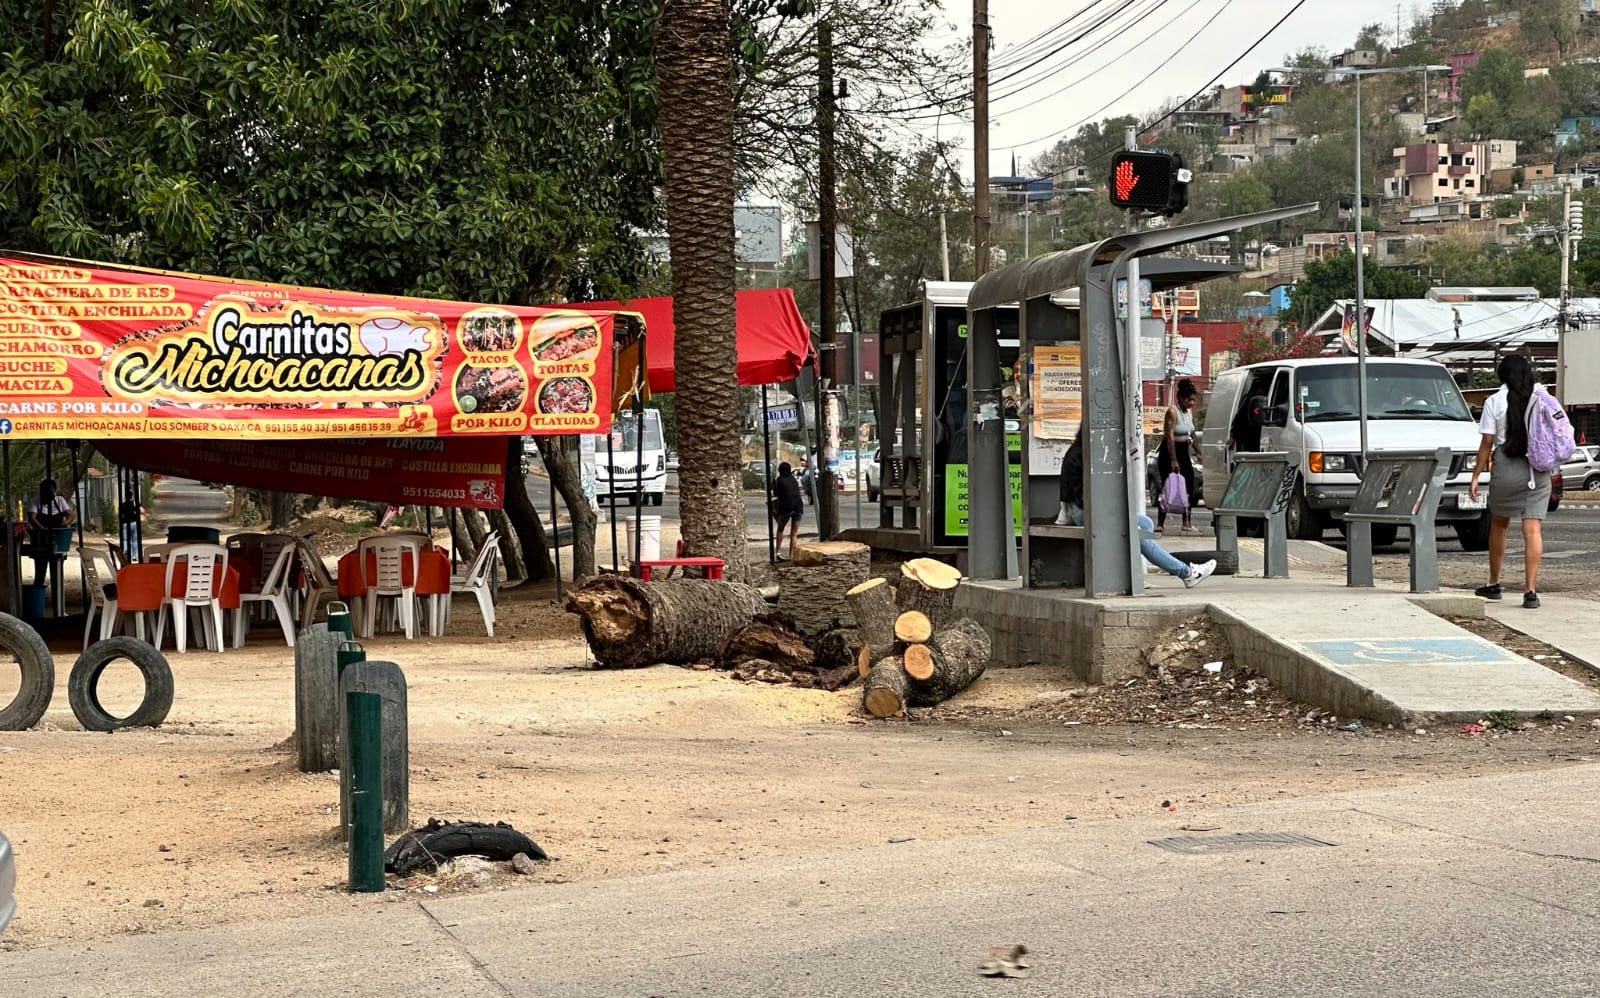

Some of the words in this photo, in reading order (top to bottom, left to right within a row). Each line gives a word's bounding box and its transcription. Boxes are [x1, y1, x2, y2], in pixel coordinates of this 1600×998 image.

[0, 286, 104, 298] ARRACHERA
[109, 287, 132, 298] DE
[136, 288, 170, 299] RES
[0, 303, 79, 317] COSTILLA
[84, 305, 186, 318] ENCHILADA
[0, 323, 73, 337] CUERITO
[214, 310, 349, 356] Carnitas
[0, 342, 96, 355] CHAMORRO
[115, 338, 424, 393] Michoacanas
[470, 355, 509, 364] TACOS
[0, 361, 56, 372] BUCHE
[538, 362, 590, 375] TORTAS
[0, 380, 65, 391] MACIZA
[0, 402, 57, 414] CARNE
[62, 402, 97, 414] POR
[101, 402, 143, 414] KILO
[15, 422, 64, 431] CARNITAS
[66, 421, 141, 431] MICHOACANAS
[149, 421, 167, 431] LOS
[219, 423, 261, 432] OAXACA
[265, 423, 280, 432] 951
[283, 423, 298, 432] 155
[300, 423, 312, 432] 40
[332, 423, 347, 432] 951
[349, 423, 367, 432] 456
[369, 423, 378, 431] 15
[380, 423, 391, 431] 39
[456, 417, 485, 428] POR
[488, 416, 522, 428] KILO
[534, 416, 595, 427] TLAYUDAS
[402, 486, 466, 500] 9511554033
